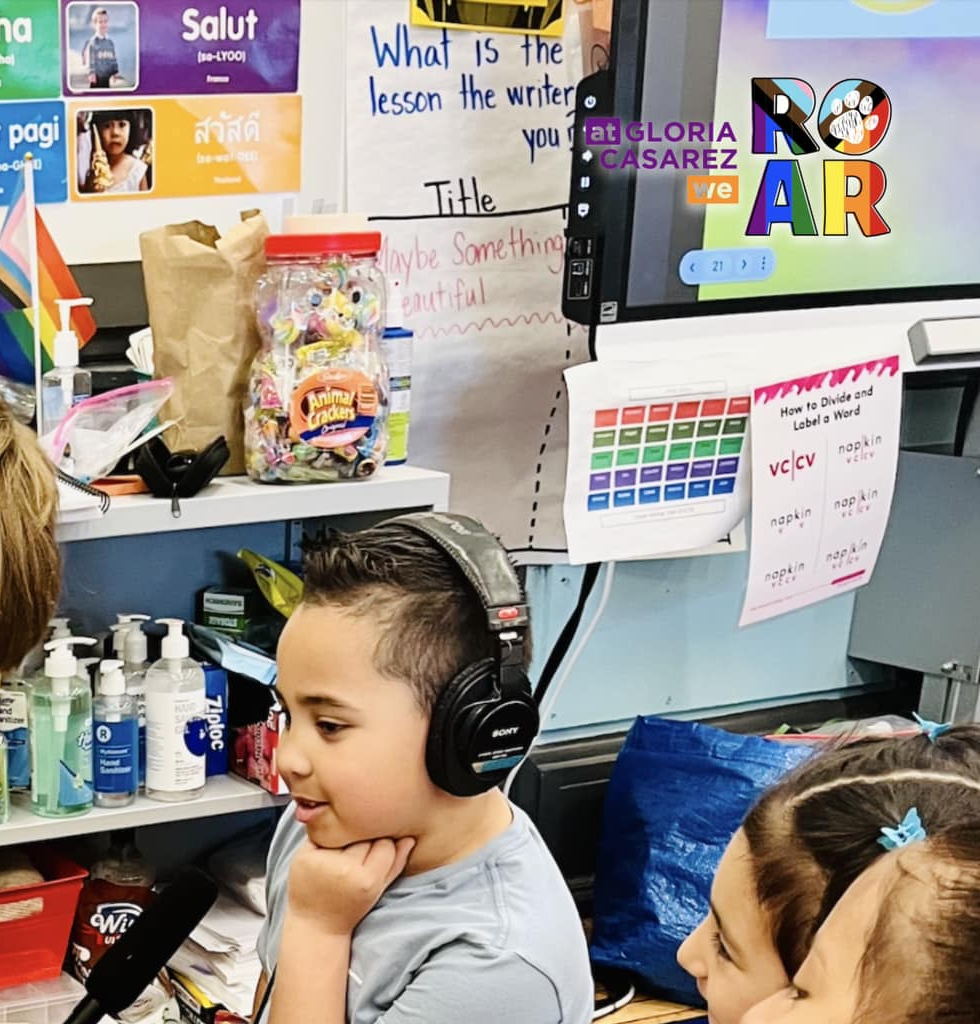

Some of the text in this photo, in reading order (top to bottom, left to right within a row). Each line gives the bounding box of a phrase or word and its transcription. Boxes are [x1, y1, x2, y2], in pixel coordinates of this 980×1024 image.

[182, 7, 258, 41] Salut
[370, 23, 563, 69] What is the
[369, 73, 575, 117] lesson the writer
[8, 114, 60, 151] pagi
[522, 127, 560, 164] you
[424, 177, 496, 216] Title
[452, 227, 565, 275] Something
[712, 260, 724, 272] 21
[402, 277, 487, 317] eautiful
[308, 386, 357, 412] Animal
[780, 385, 874, 418] How to Divide and
[308, 404, 357, 431] Crackers
[794, 404, 861, 431] Label a Word
[770, 507, 812, 528] napkin
[204, 694, 226, 752] Ziploc
[491, 726, 519, 738] SONY
